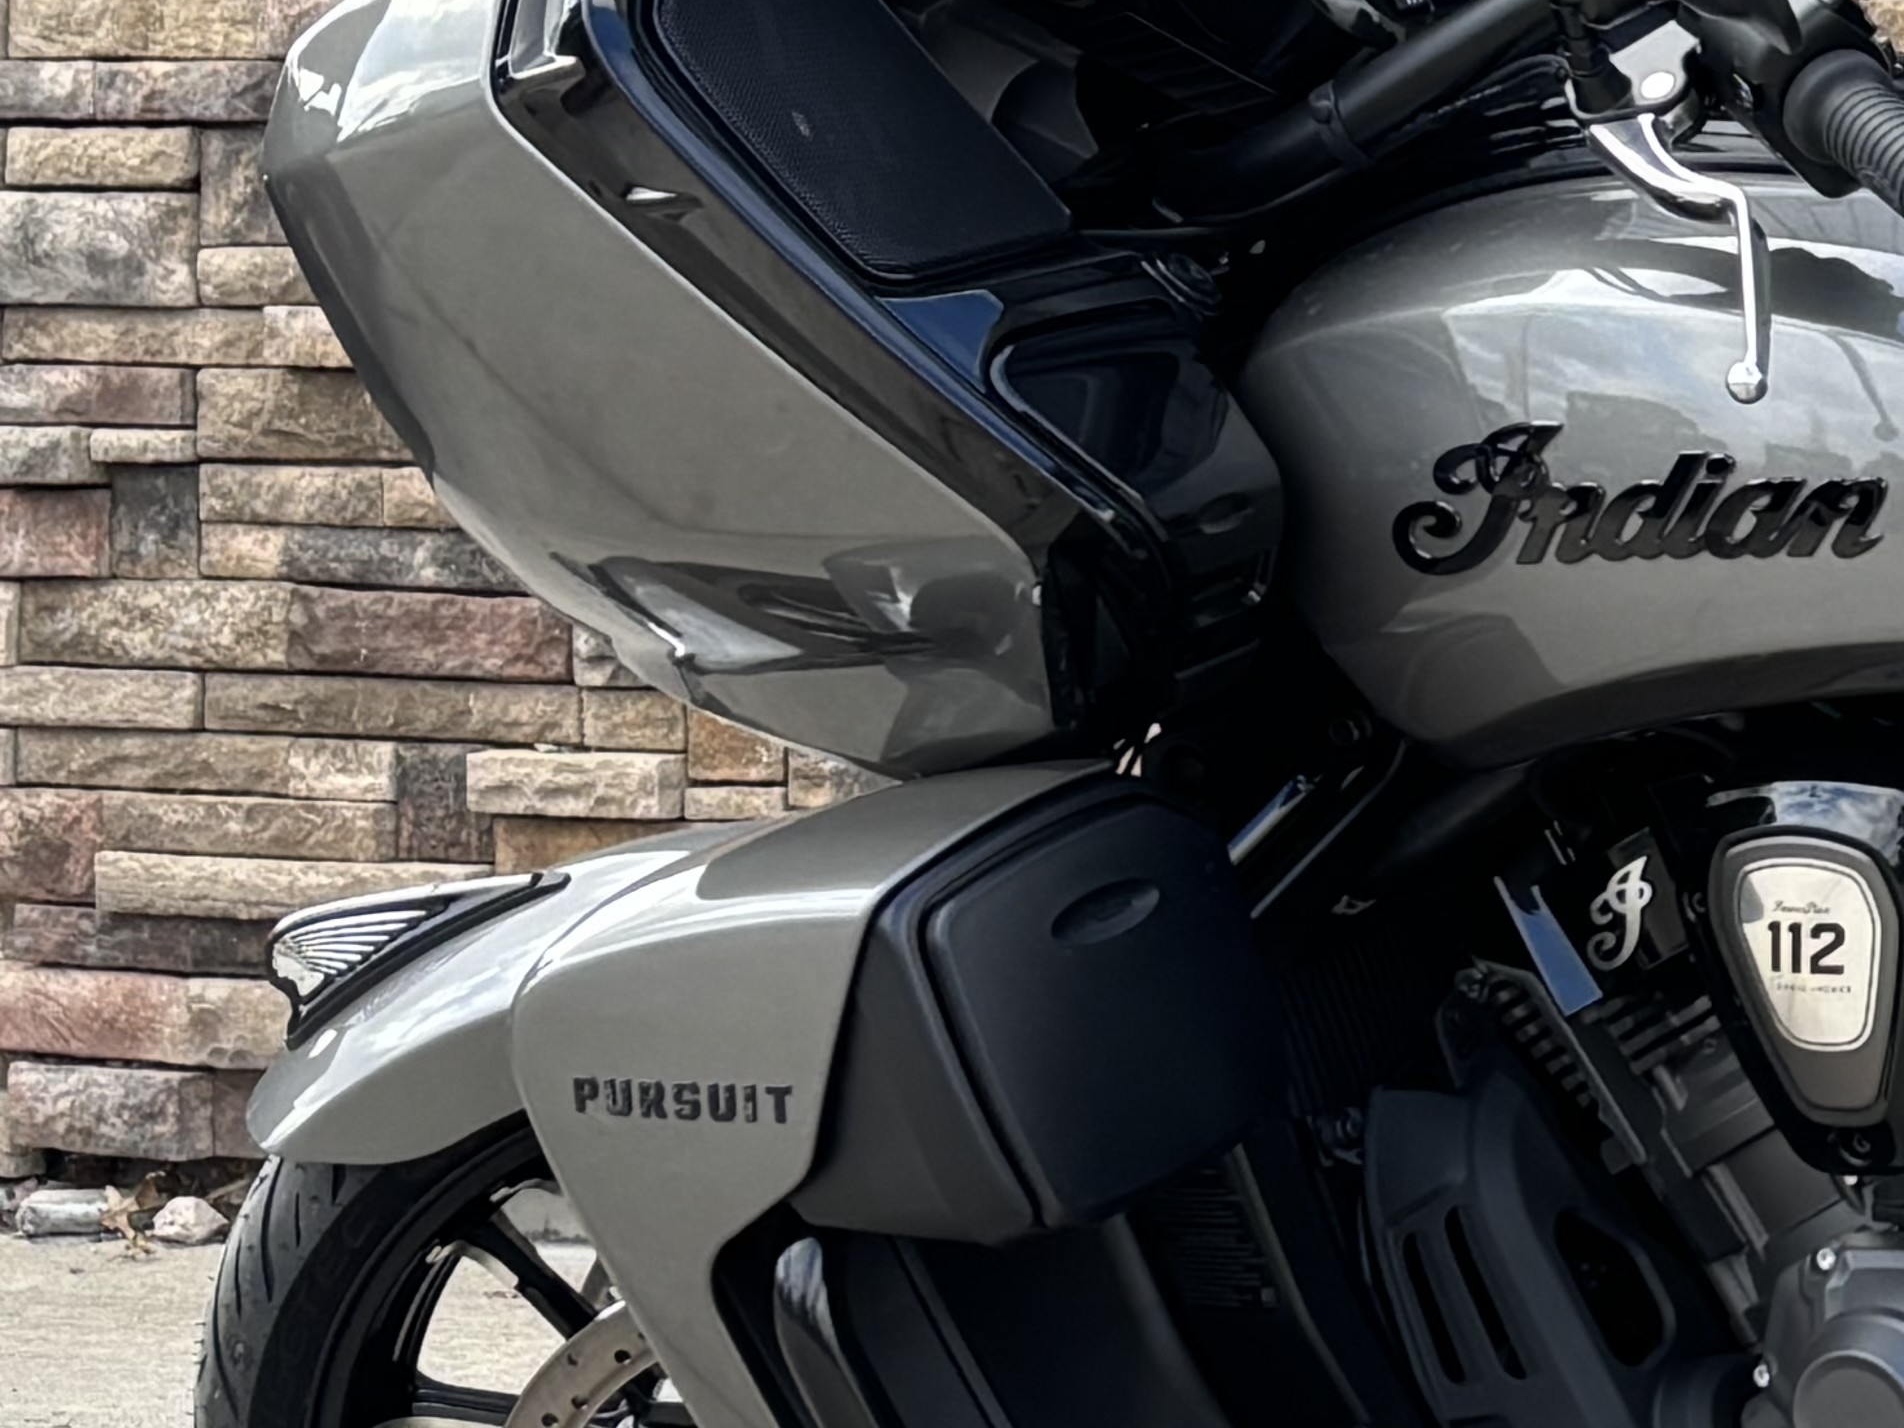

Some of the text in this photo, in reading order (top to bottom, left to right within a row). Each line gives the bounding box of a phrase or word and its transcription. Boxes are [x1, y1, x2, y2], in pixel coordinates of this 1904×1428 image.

[1392, 419, 1890, 577] Indian
[1767, 920, 1847, 976] 112
[573, 1076, 794, 1125] PURSUIT
